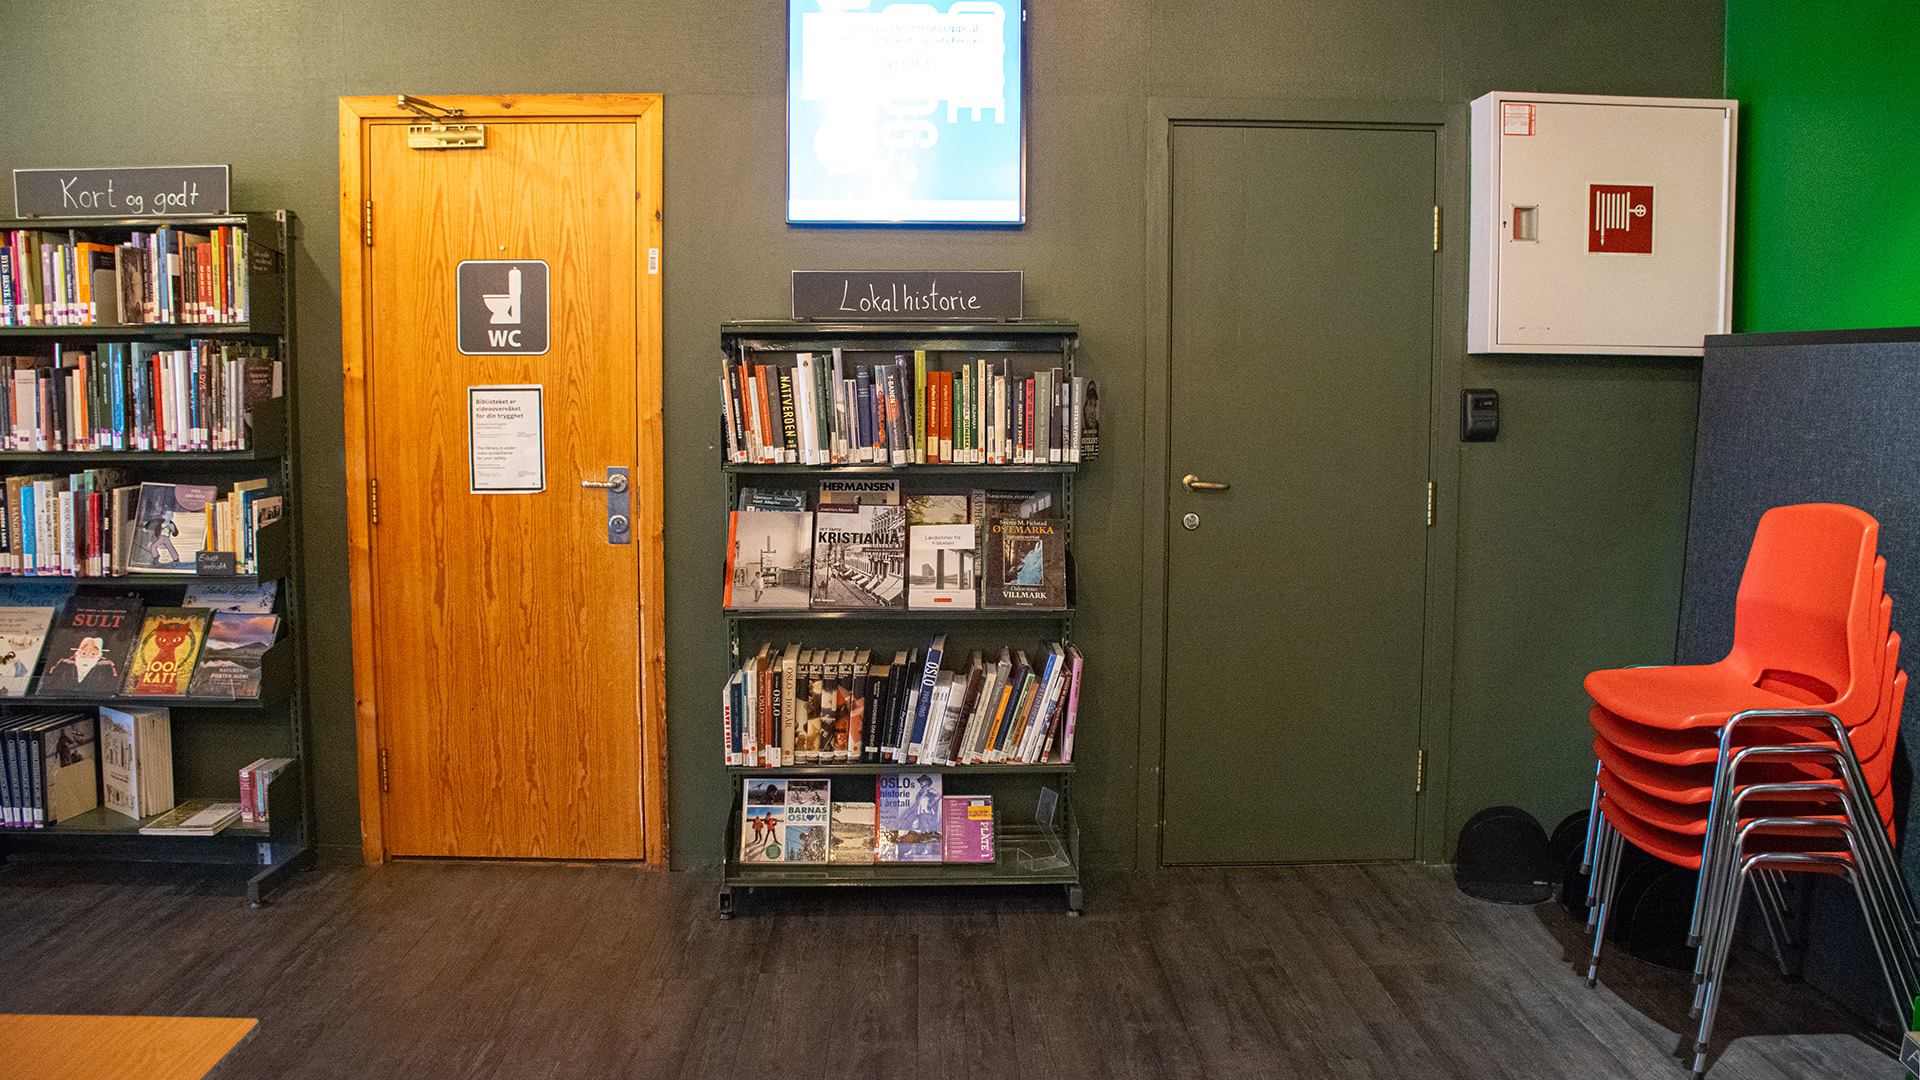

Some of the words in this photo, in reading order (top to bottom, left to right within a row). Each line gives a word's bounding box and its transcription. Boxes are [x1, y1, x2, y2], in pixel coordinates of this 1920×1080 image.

[61, 177, 117, 208] Kort
[126, 194, 143, 213] og
[153, 181, 199, 214] godt
[840, 279, 980, 312] Lokalhistorie
[488, 330, 521, 347] WC
[823, 483, 894, 491] HERMANSEN
[993, 525, 1054, 534] ØSTMARKA
[819, 532, 899, 544] KRISTIANIA
[72, 614, 125, 628] SULT
[142, 673, 177, 683] KATT
[923, 662, 939, 686] OSLO
[785, 717, 793, 728] ÅR
[880, 778, 915, 789] OSLOs
[885, 799, 910, 807] årstall
[981, 822, 991, 851] PLATE
